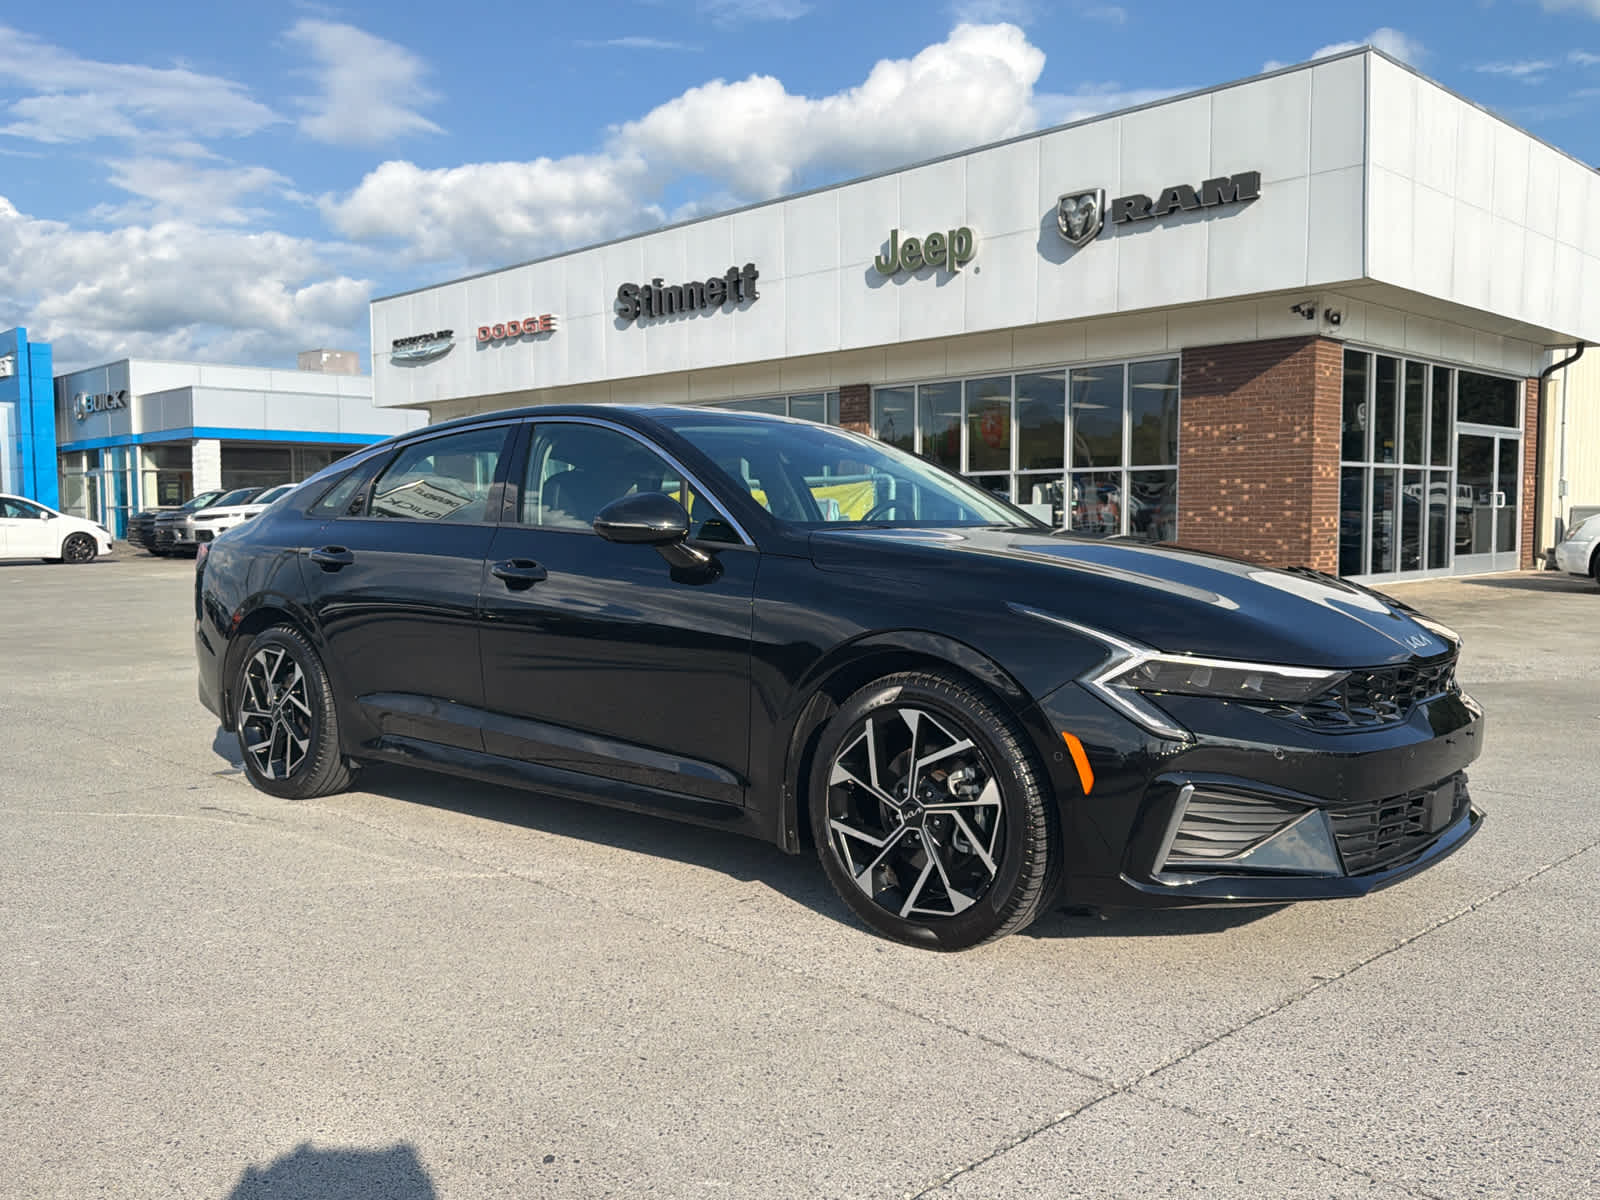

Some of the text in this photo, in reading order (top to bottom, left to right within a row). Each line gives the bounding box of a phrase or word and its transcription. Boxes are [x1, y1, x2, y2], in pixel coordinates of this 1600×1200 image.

[1112, 171, 1261, 224] RAM
[874, 226, 977, 273] Jeep
[617, 262, 760, 321] Stinnett
[477, 313, 556, 342] DODGE
[85, 390, 127, 413] BUICK
